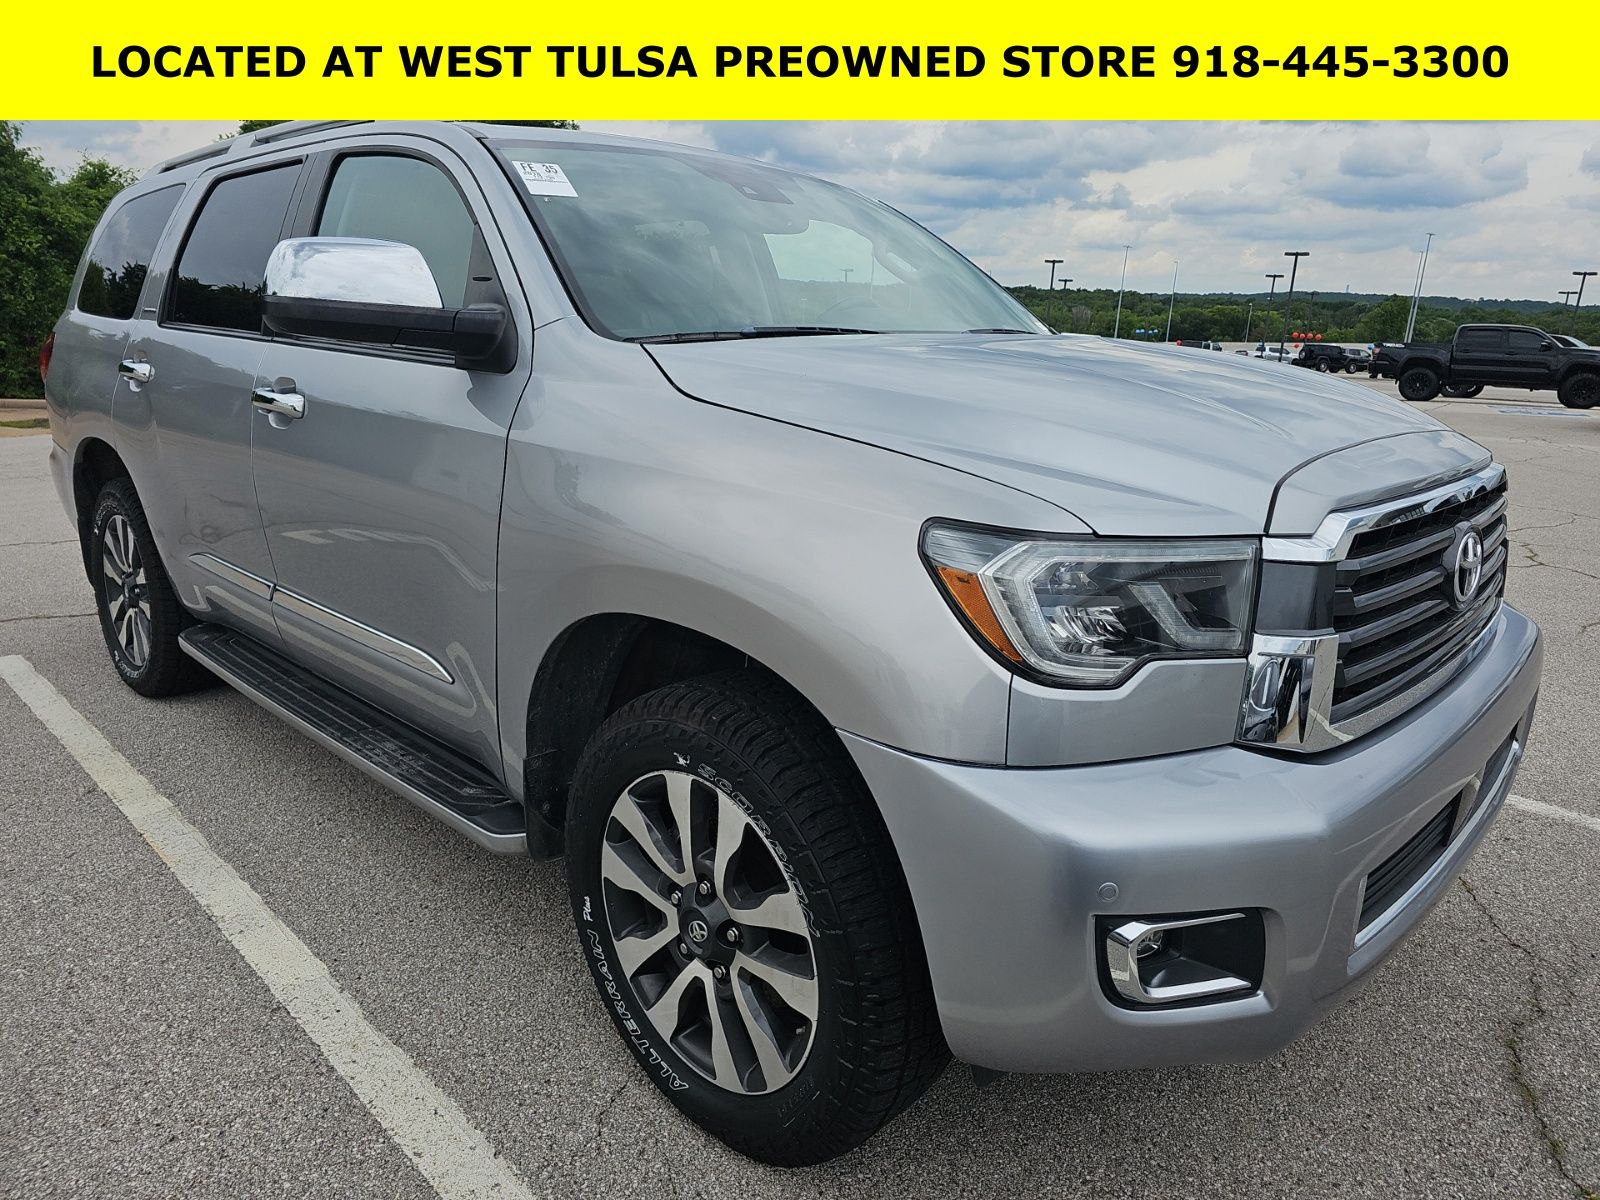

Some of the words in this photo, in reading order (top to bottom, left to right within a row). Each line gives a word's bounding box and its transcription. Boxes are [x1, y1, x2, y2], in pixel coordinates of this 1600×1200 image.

[520, 162, 537, 172] FE
[542, 164, 558, 174] 35
[697, 763, 821, 938] SCORPION
